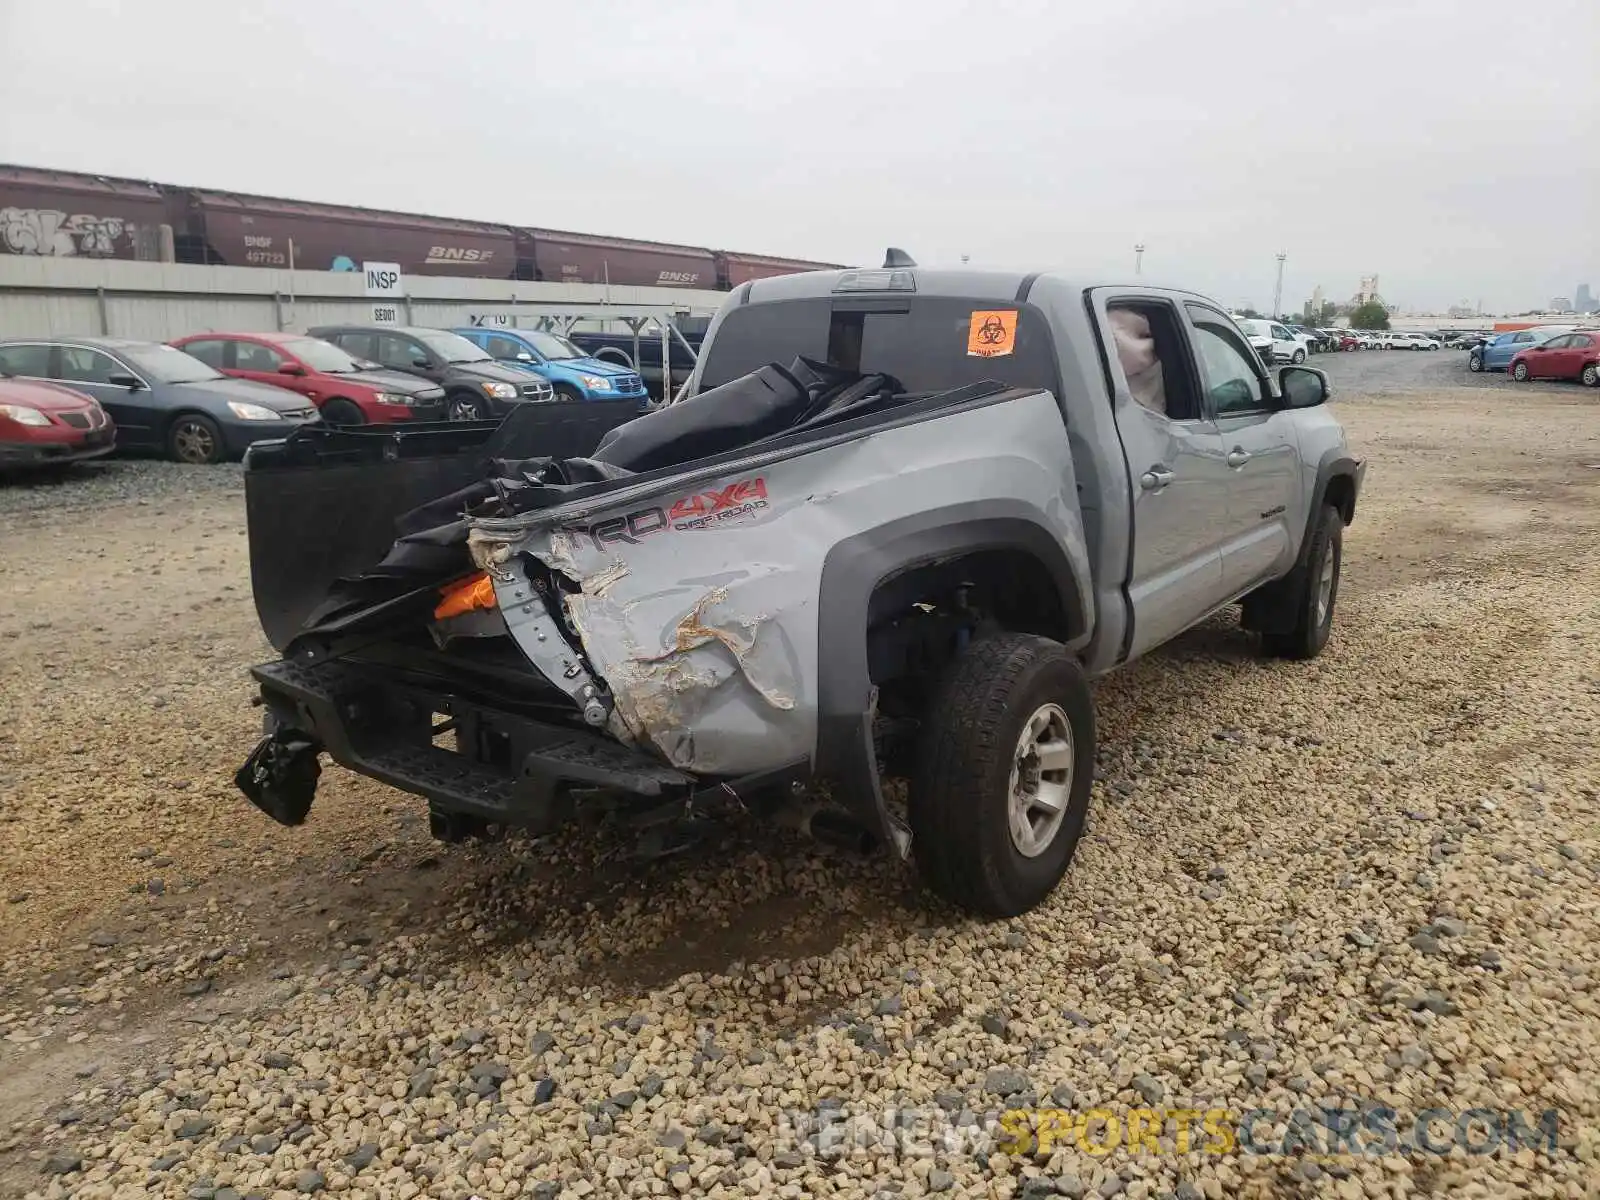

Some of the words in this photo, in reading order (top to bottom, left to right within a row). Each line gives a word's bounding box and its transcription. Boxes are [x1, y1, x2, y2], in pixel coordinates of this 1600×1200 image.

[428, 246, 495, 261] BNSF
[367, 271, 398, 289] INSP
[659, 270, 700, 282] BNSF
